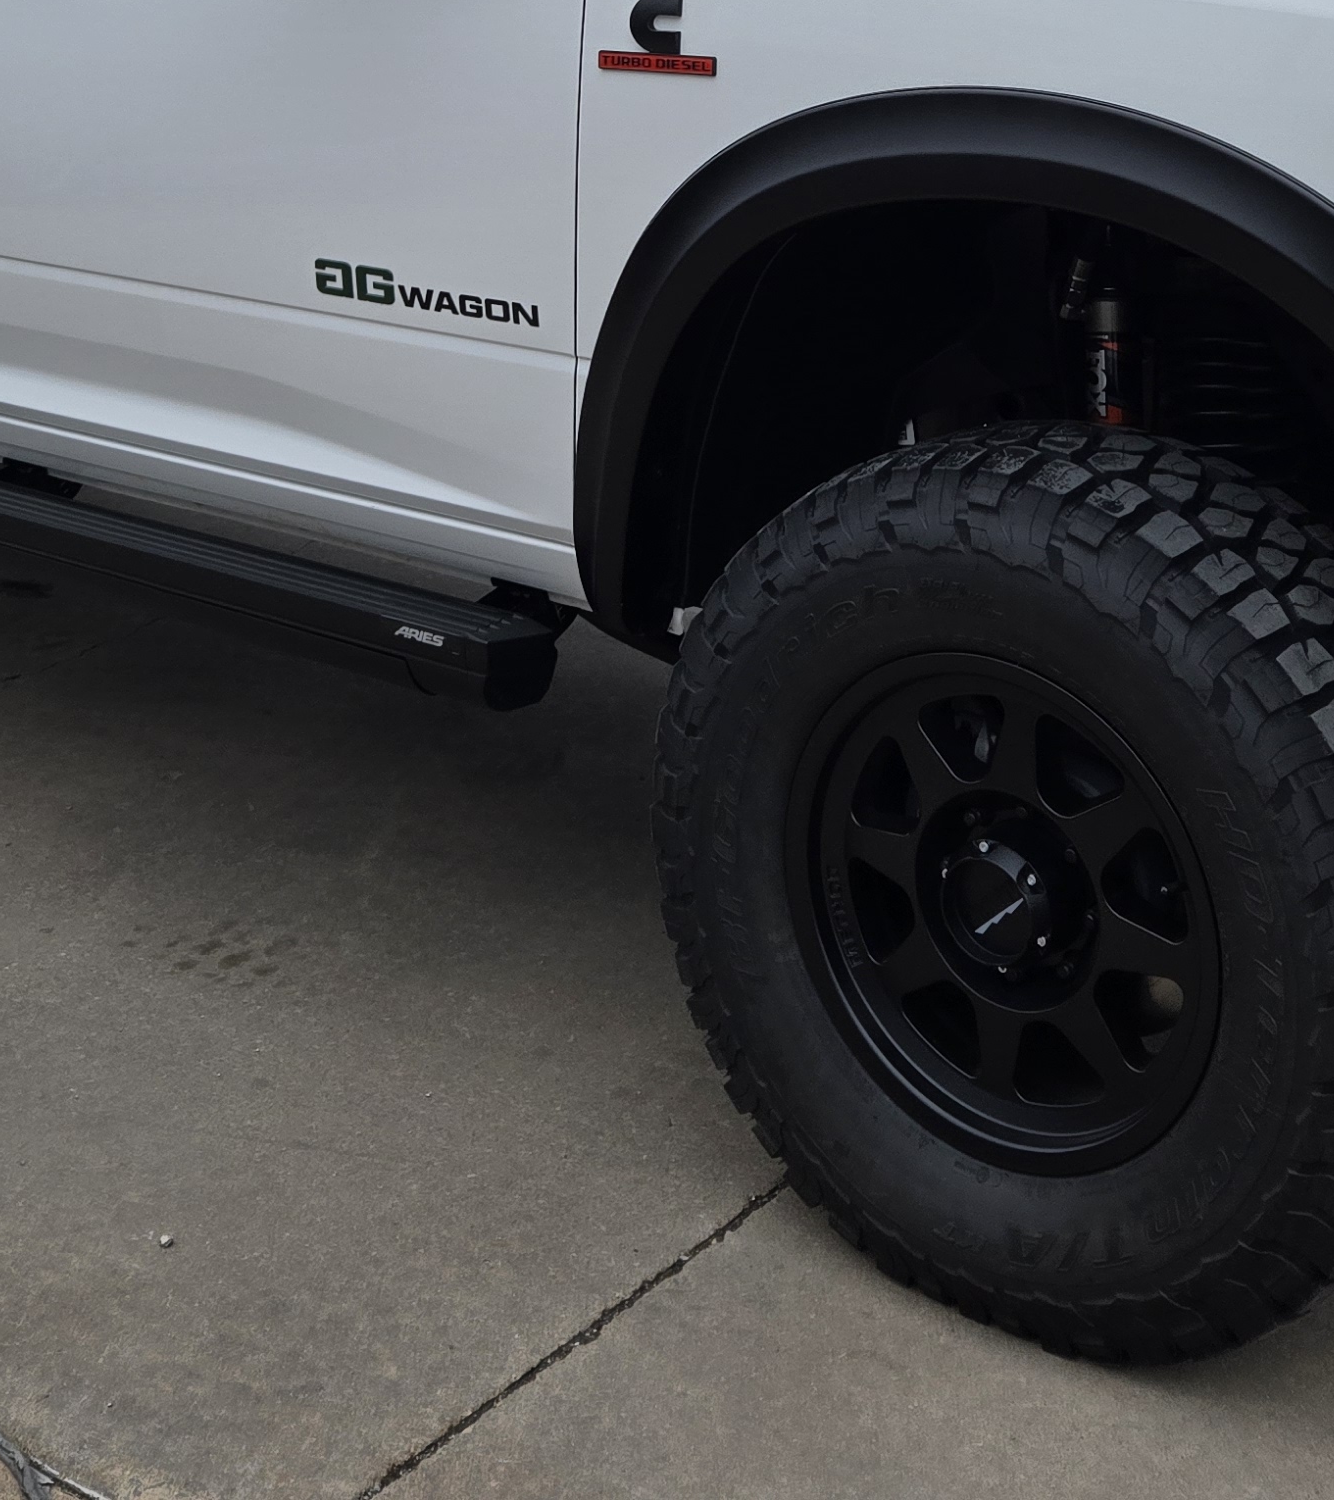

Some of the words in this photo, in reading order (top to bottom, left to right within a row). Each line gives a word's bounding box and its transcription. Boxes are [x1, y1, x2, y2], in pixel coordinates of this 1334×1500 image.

[602, 55, 652, 68] TURBO
[655, 58, 711, 72] DIESEL
[398, 284, 540, 327] WAGON
[1087, 349, 1107, 418] FOX
[394, 625, 445, 647] ARIES
